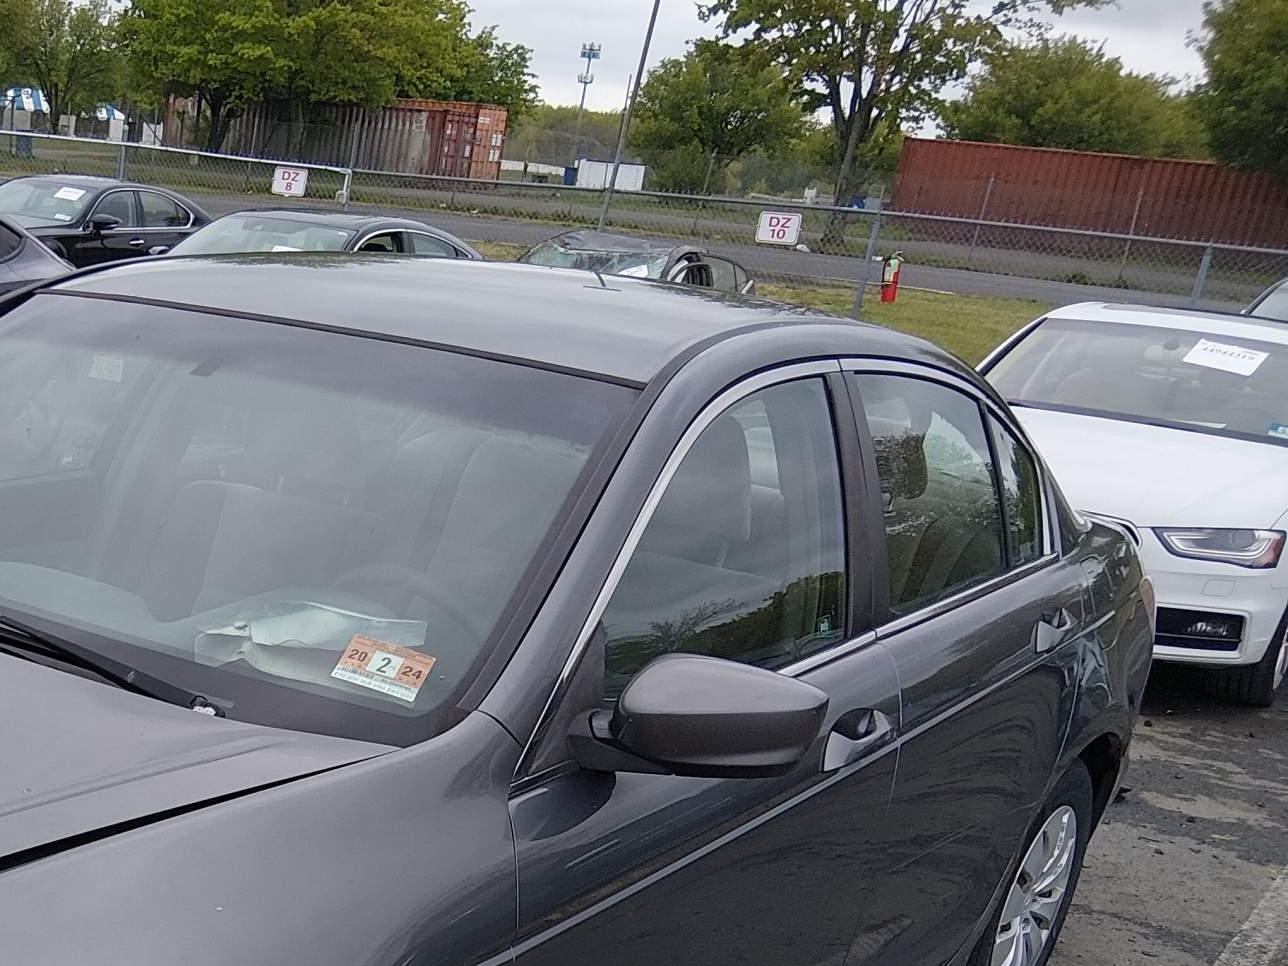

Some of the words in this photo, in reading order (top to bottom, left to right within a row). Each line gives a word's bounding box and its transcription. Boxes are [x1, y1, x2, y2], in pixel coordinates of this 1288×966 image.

[282, 171, 300, 182] DZ
[285, 182, 292, 191] 8
[769, 217, 792, 228] DZ
[770, 229, 786, 239] 10
[348, 649, 368, 662] 20
[376, 657, 392, 674] 2
[401, 666, 423, 680] 24
